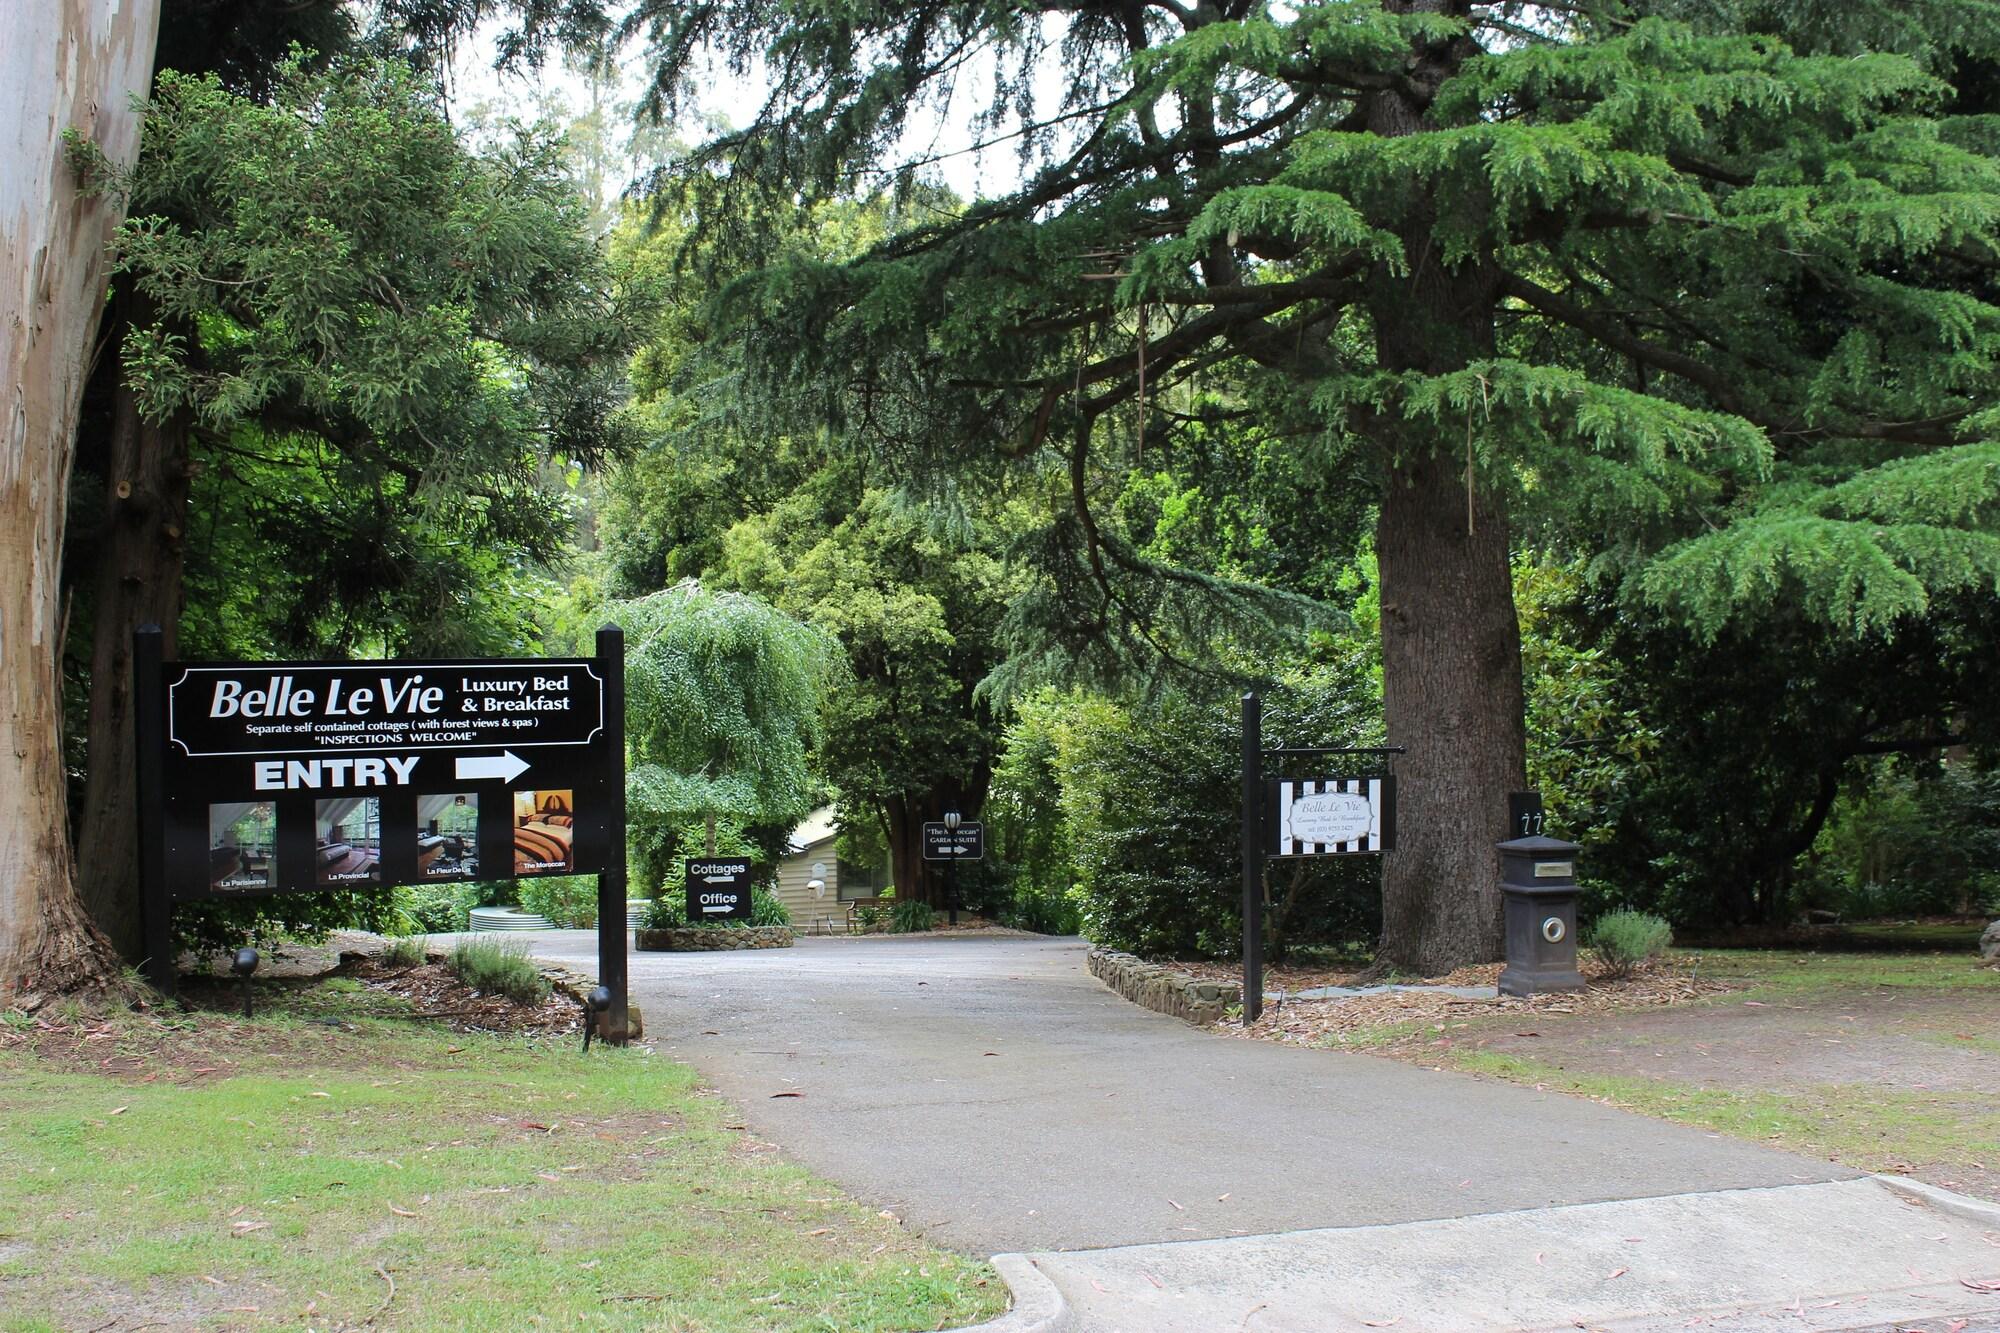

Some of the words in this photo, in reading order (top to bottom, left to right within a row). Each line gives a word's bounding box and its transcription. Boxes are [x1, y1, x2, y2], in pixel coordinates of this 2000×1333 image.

[462, 677, 528, 696] Luxury
[533, 675, 569, 691] Bed
[209, 675, 315, 718] Belle
[324, 678, 374, 716] Le
[380, 674, 444, 714] Vie
[461, 697, 478, 712] &
[483, 695, 571, 712] Breakfast
[246, 723, 292, 736] Separate
[293, 722, 313, 733] self
[314, 721, 365, 732] contained
[367, 721, 409, 733] cottages
[417, 719, 440, 730] with
[442, 718, 470, 729] forest
[472, 718, 499, 728] views
[501, 718, 510, 728] &
[512, 718, 533, 730] spas
[314, 733, 403, 745] "INSPECTIONS
[409, 731, 477, 742] WELCOME"
[255, 756, 421, 790] ENTRY
[1302, 801, 1325, 813] Belle
[1328, 801, 1340, 812] Le
[1345, 800, 1361, 811] Vie
[1521, 812, 1542, 835] 77
[427, 867, 436, 875] La
[536, 861, 566, 869] Moroccan
[691, 864, 746, 876] Cottages
[338, 872, 370, 880] Provincial
[221, 880, 231, 888] La
[231, 879, 267, 887] Parisienne
[700, 892, 738, 904] Office
